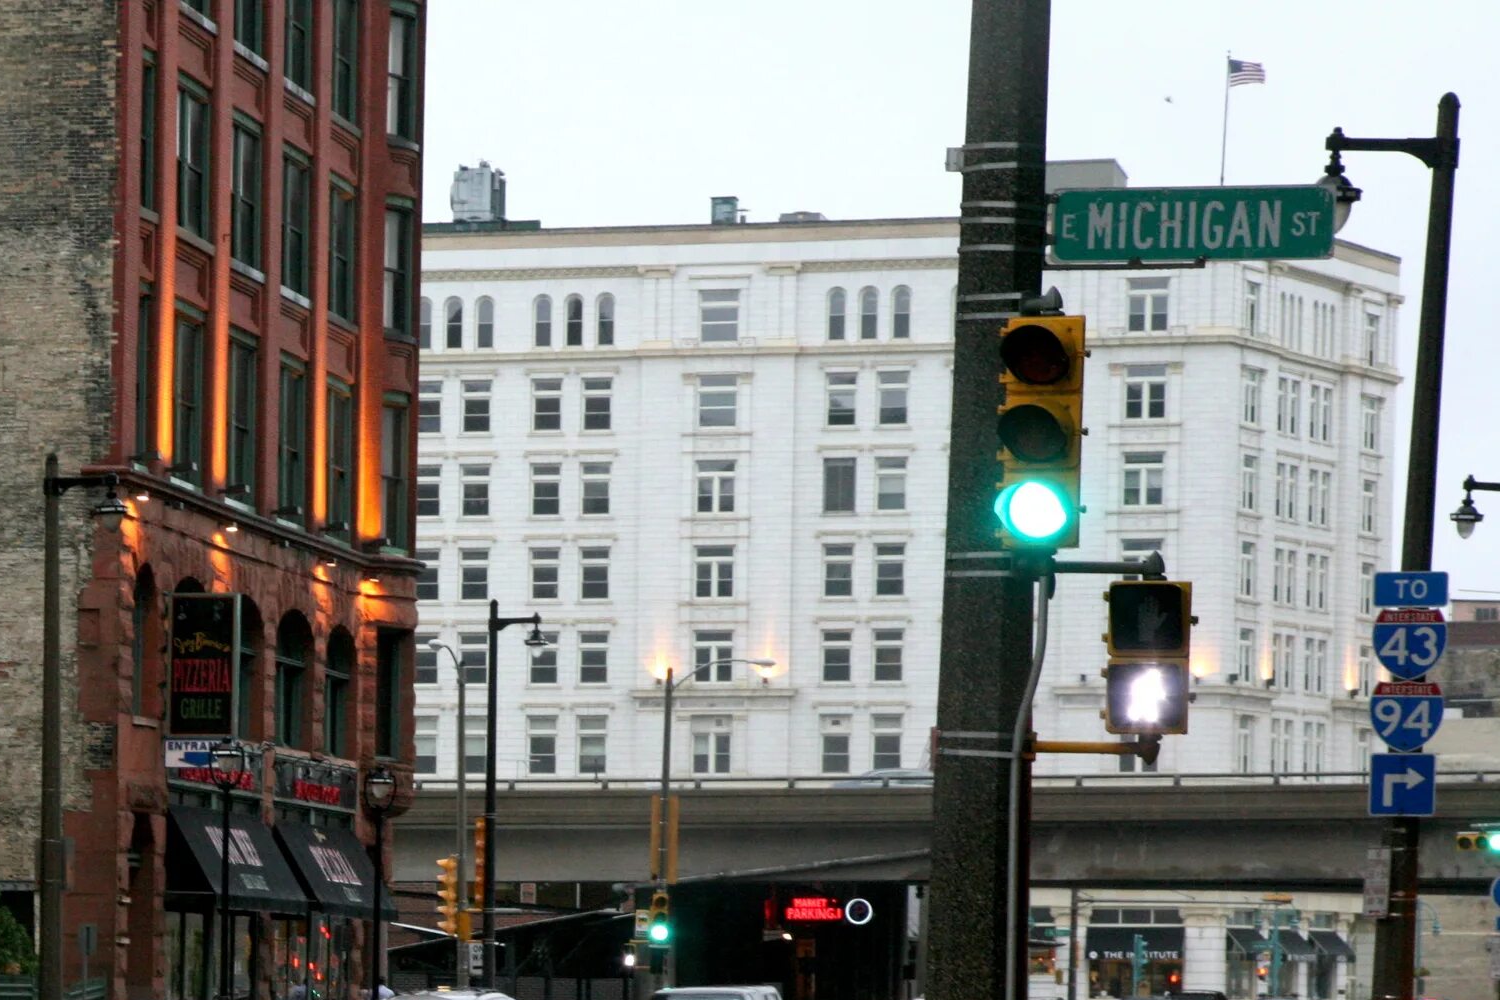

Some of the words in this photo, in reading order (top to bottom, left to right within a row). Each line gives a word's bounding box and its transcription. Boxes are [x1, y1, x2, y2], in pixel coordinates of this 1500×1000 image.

[1062, 214, 1077, 239] E
[1087, 200, 1282, 249] MICHIGAN
[1291, 211, 1321, 236] ST
[1394, 579, 1427, 599] TO
[1383, 612, 1437, 622] INTERSTATE
[1379, 627, 1438, 666] 43
[173, 658, 231, 692] PIZZERIA
[1381, 684, 1433, 695] INTERSTATE
[180, 699, 222, 719] GRILLE
[1374, 699, 1433, 738] 94
[1103, 951, 1123, 959] THE
